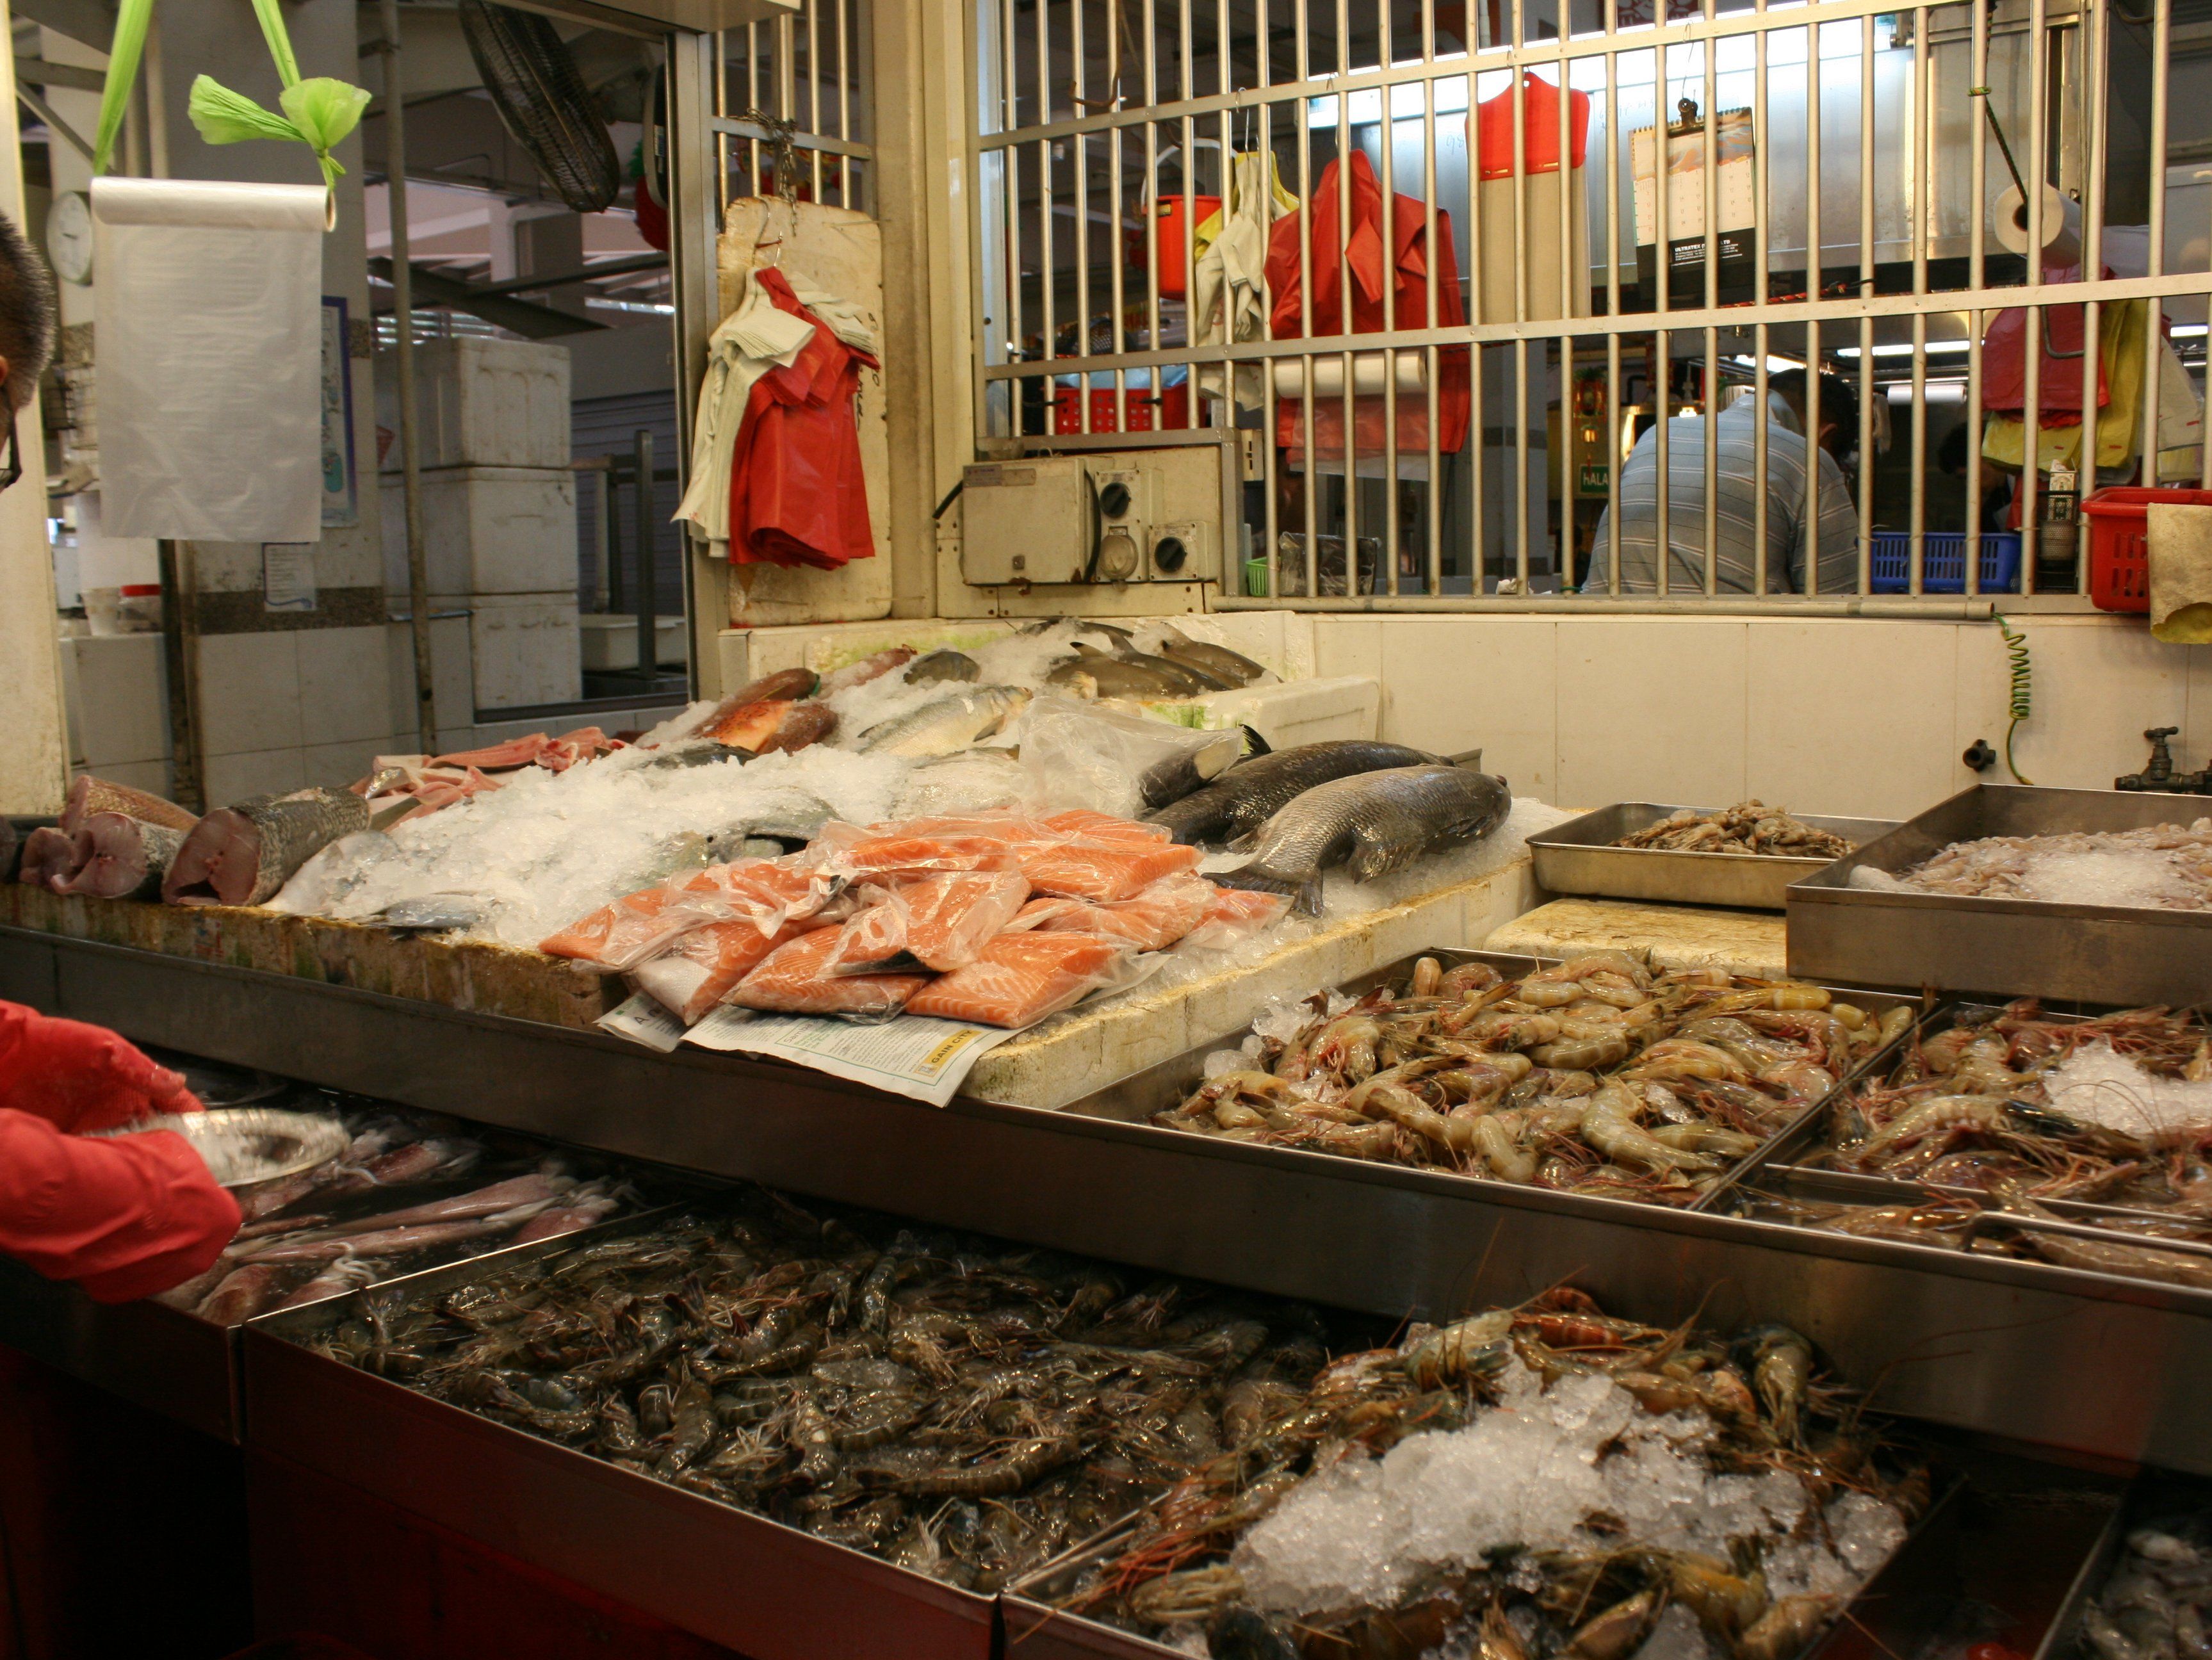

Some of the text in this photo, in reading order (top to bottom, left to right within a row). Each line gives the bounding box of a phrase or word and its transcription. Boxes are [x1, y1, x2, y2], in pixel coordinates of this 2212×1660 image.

[1674, 244, 1701, 252] ULTRATEX
[783, 1021, 813, 1043] Samba
[931, 1029, 972, 1064] GAIN CITY
